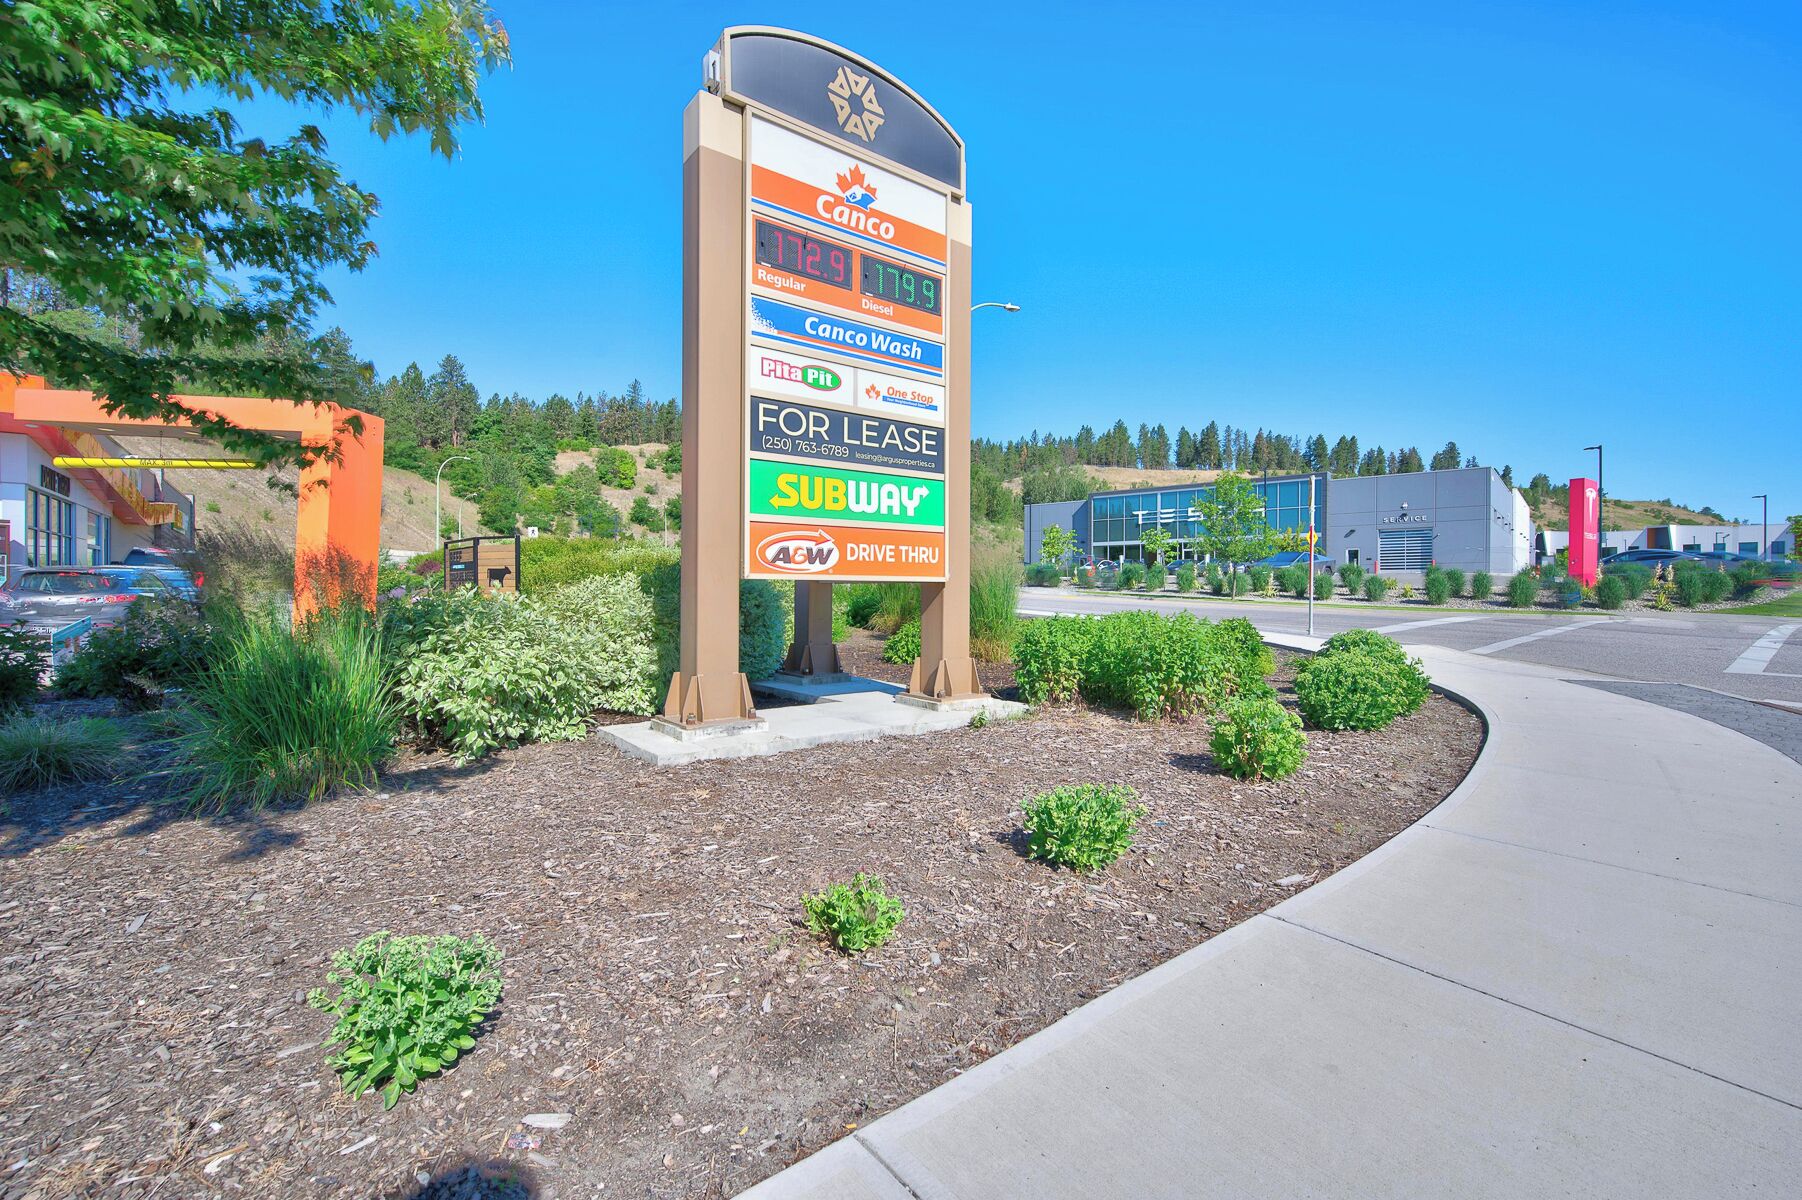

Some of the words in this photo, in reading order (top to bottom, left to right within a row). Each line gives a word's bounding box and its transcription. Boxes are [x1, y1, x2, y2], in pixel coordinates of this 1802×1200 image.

[816, 194, 895, 239] Canco
[773, 230, 845, 282] 172.9
[757, 269, 806, 291] Regular
[875, 263, 935, 308] 179.9
[861, 299, 893, 316] Diesel
[804, 316, 868, 346] Canco
[871, 331, 922, 360] Wash
[761, 357, 803, 382] Pita
[807, 368, 834, 387] Pit
[887, 386, 908, 398] One
[910, 391, 934, 405] Stop
[758, 403, 830, 440] FOR
[843, 416, 938, 456] LEASE
[762, 435, 792, 452] (250)
[795, 441, 849, 457] 763-6789
[855, 451, 936, 468] leasing@argusproperties.ca
[769, 473, 930, 517] SUBWAY
[1132, 506, 1266, 525] TES
[1383, 515, 1428, 523] SERVICE
[770, 545, 835, 565] A&W
[846, 543, 895, 562] DRIVE
[899, 545, 939, 564] THRU
